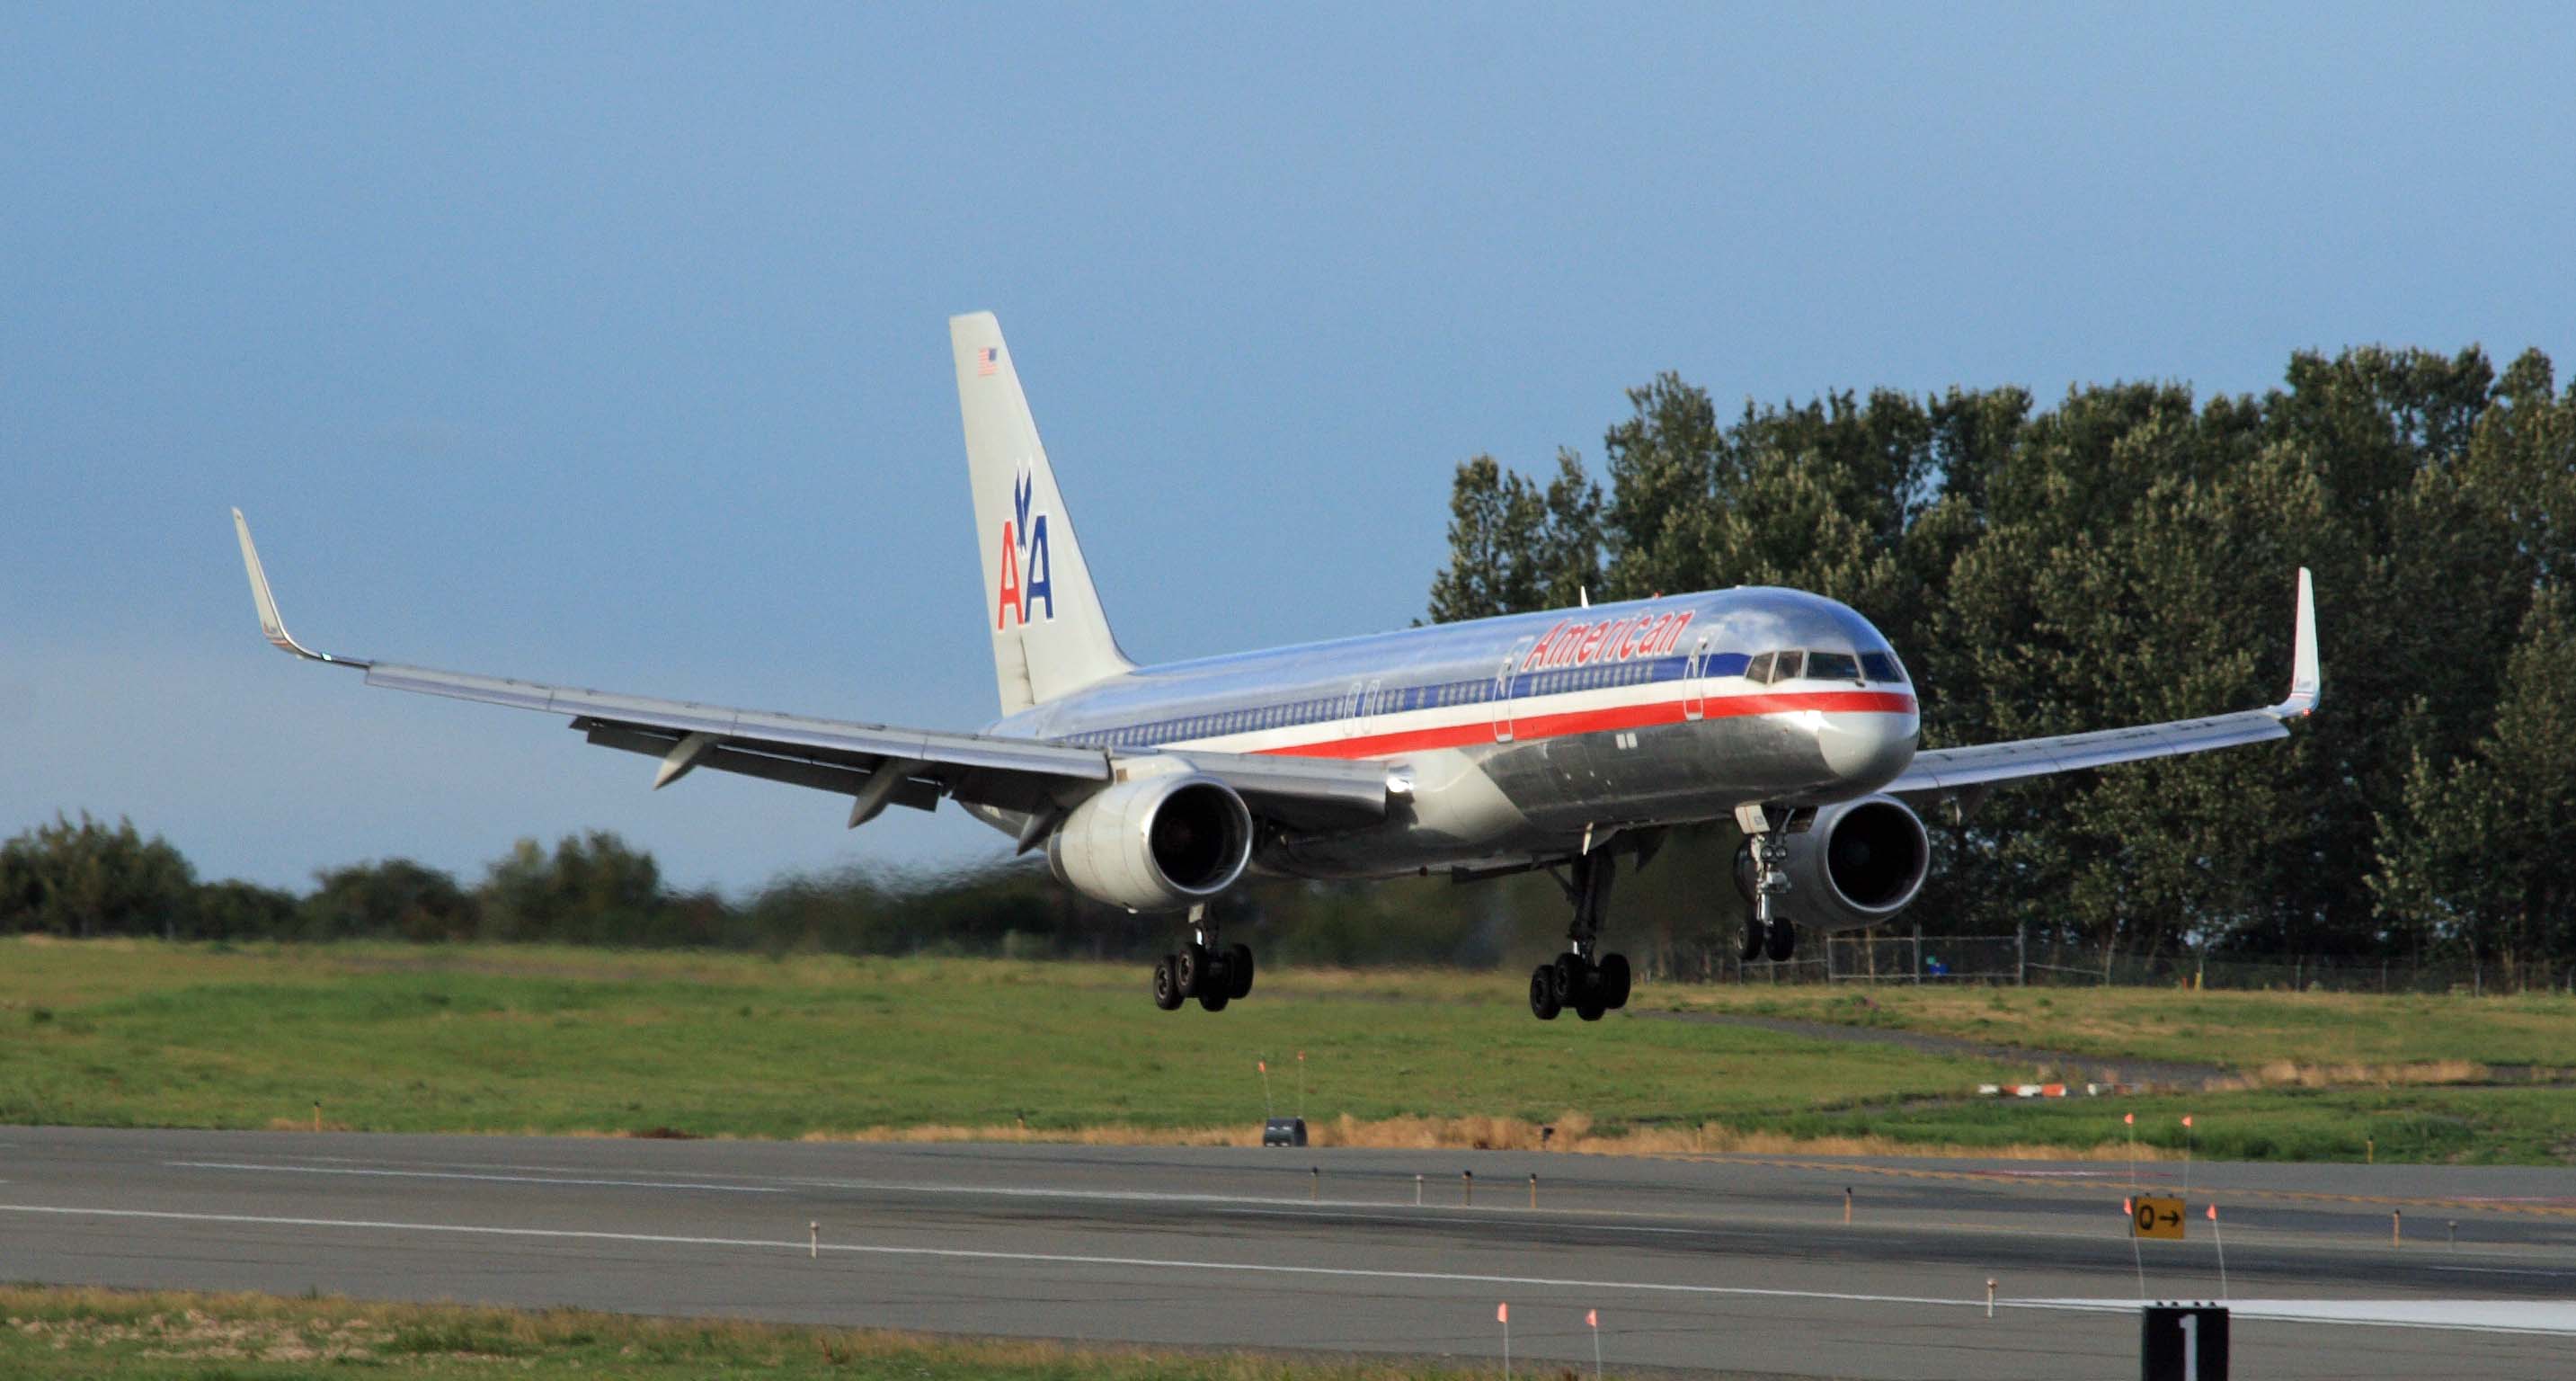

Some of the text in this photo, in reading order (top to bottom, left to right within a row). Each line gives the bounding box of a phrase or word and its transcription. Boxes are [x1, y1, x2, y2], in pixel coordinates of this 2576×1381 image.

[998, 514, 1054, 630] AA
[1522, 610, 1693, 672] American
[2179, 1314, 2198, 1381] 1
